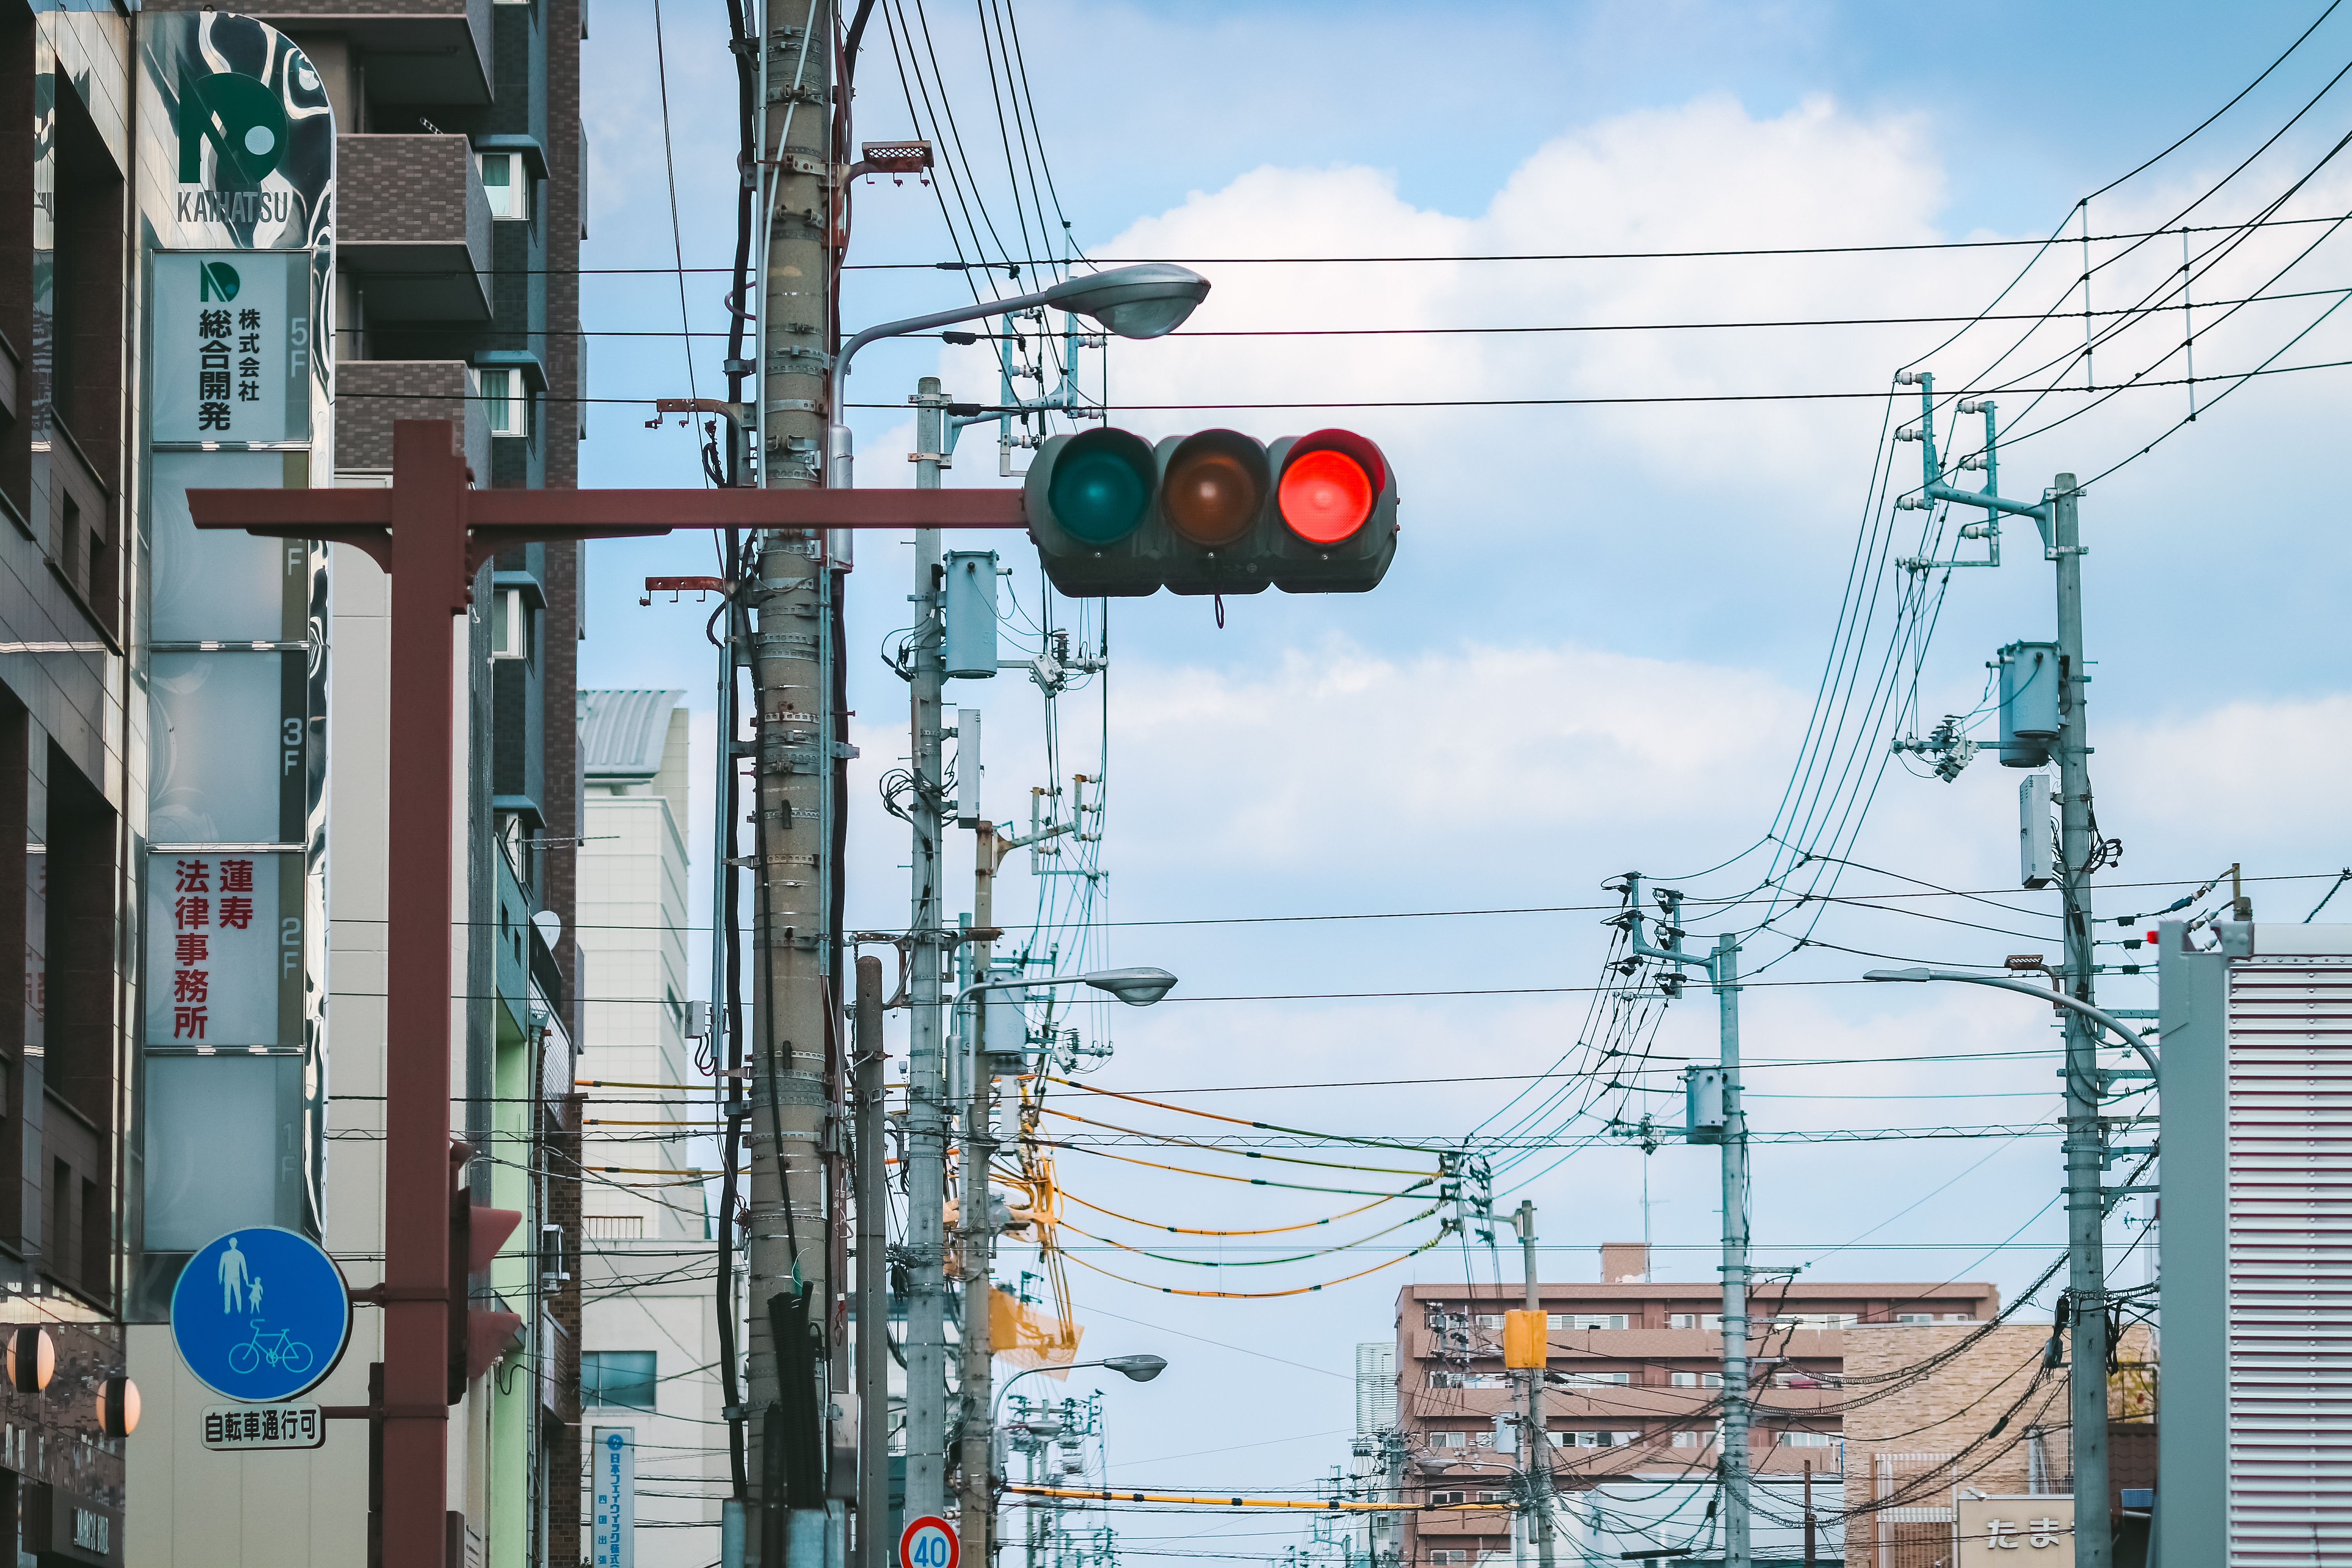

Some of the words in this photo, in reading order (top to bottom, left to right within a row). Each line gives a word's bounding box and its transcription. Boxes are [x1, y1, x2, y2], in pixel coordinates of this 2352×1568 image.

[178, 192, 288, 223] KAIHATSU
[198, 309, 232, 431] 総合開発
[238, 308, 260, 402] 株式会社
[283, 718, 303, 776] 3F
[219, 859, 253, 930] 蓮寿
[174, 859, 210, 1039] 法律事務所
[205, 1409, 317, 1443] 自転車通行可
[914, 1536, 946, 1568] 40
[1987, 1517, 2075, 1549] たま
